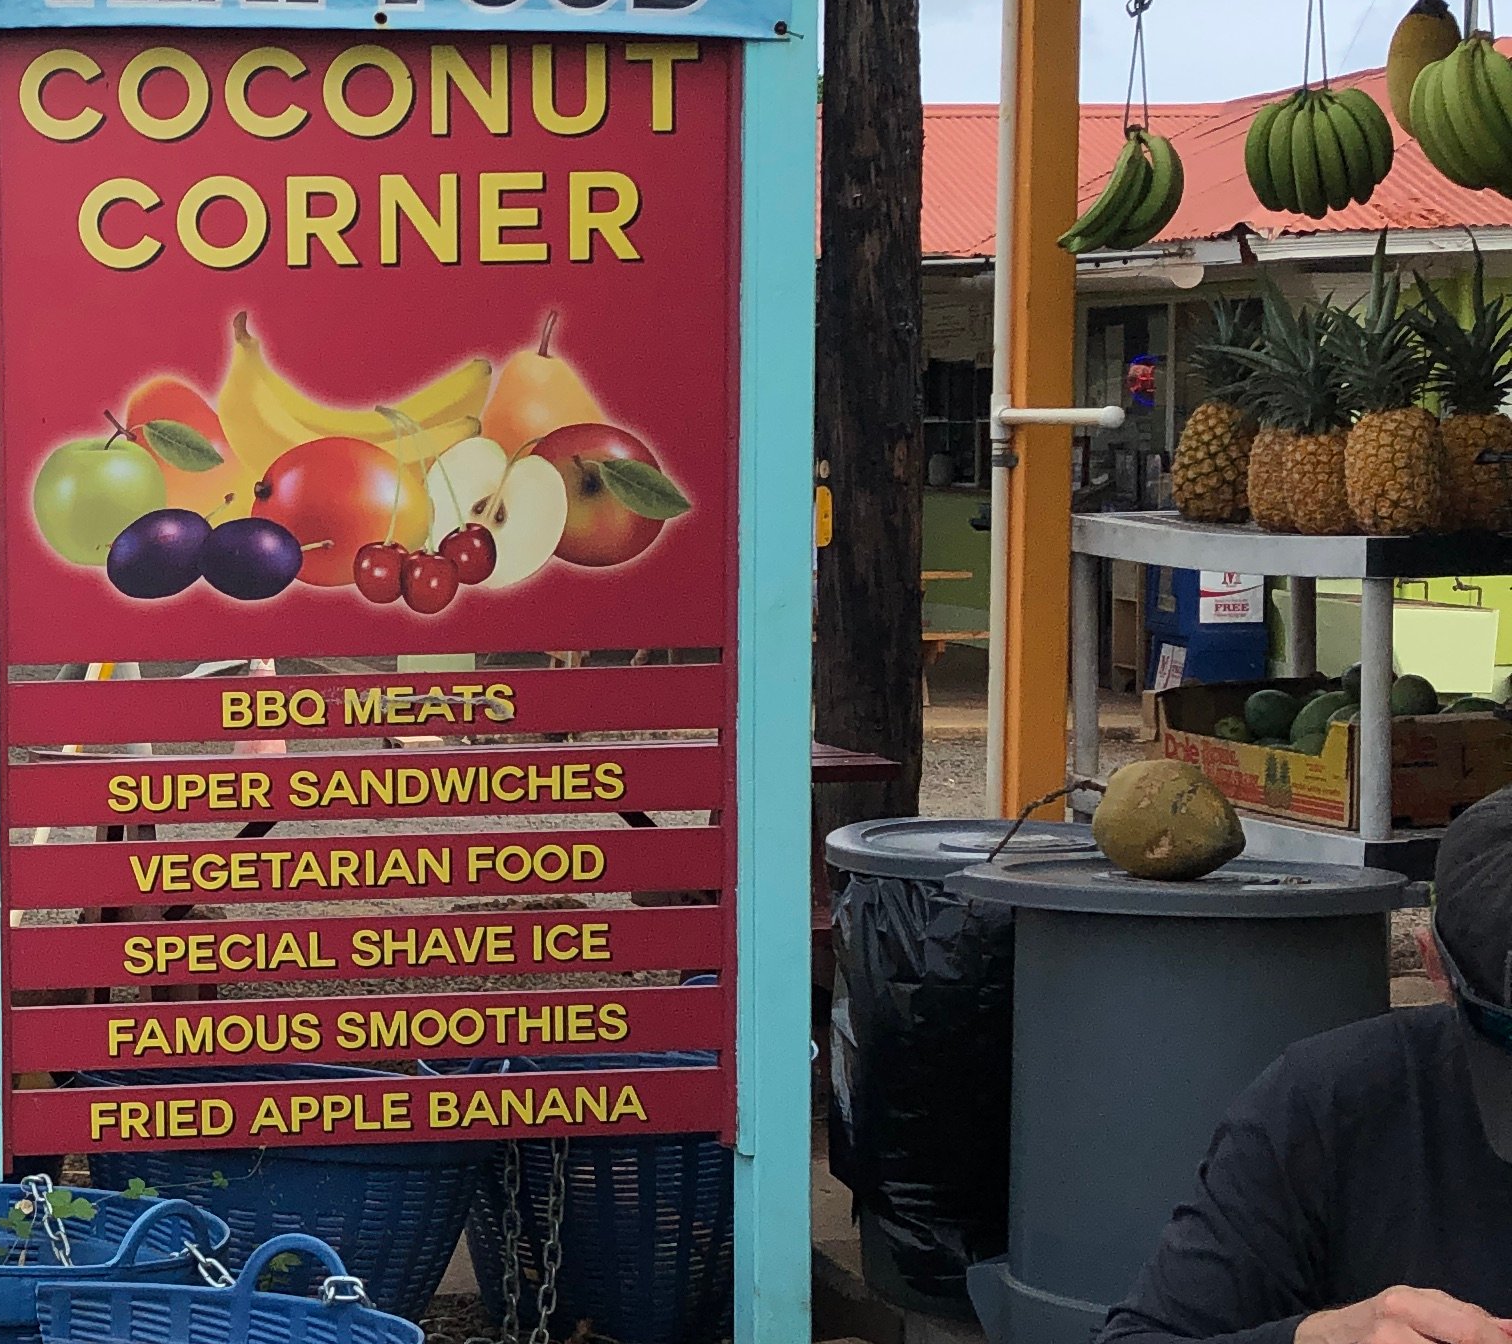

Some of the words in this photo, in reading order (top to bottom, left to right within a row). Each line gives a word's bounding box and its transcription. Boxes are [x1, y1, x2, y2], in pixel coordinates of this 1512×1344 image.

[19, 42, 701, 141] COCONUT
[78, 170, 643, 271] CORNER
[1214, 603, 1249, 612] FREE
[222, 688, 326, 729] BBQ
[344, 683, 516, 726] MEATS
[107, 771, 272, 813] SUPER
[288, 761, 626, 809] SANDWICHES
[129, 846, 452, 893] VEGETARIAN
[467, 843, 606, 883] FOOD
[123, 931, 337, 975] SPECIAL
[350, 924, 516, 968] SHAVE
[531, 922, 611, 962] ICE
[107, 1012, 322, 1057] FAMOUS
[336, 1002, 629, 1050] SMOOTHIES
[90, 1098, 235, 1141] FRIED
[250, 1091, 413, 1135] APPLE
[428, 1085, 649, 1129] BANANA
